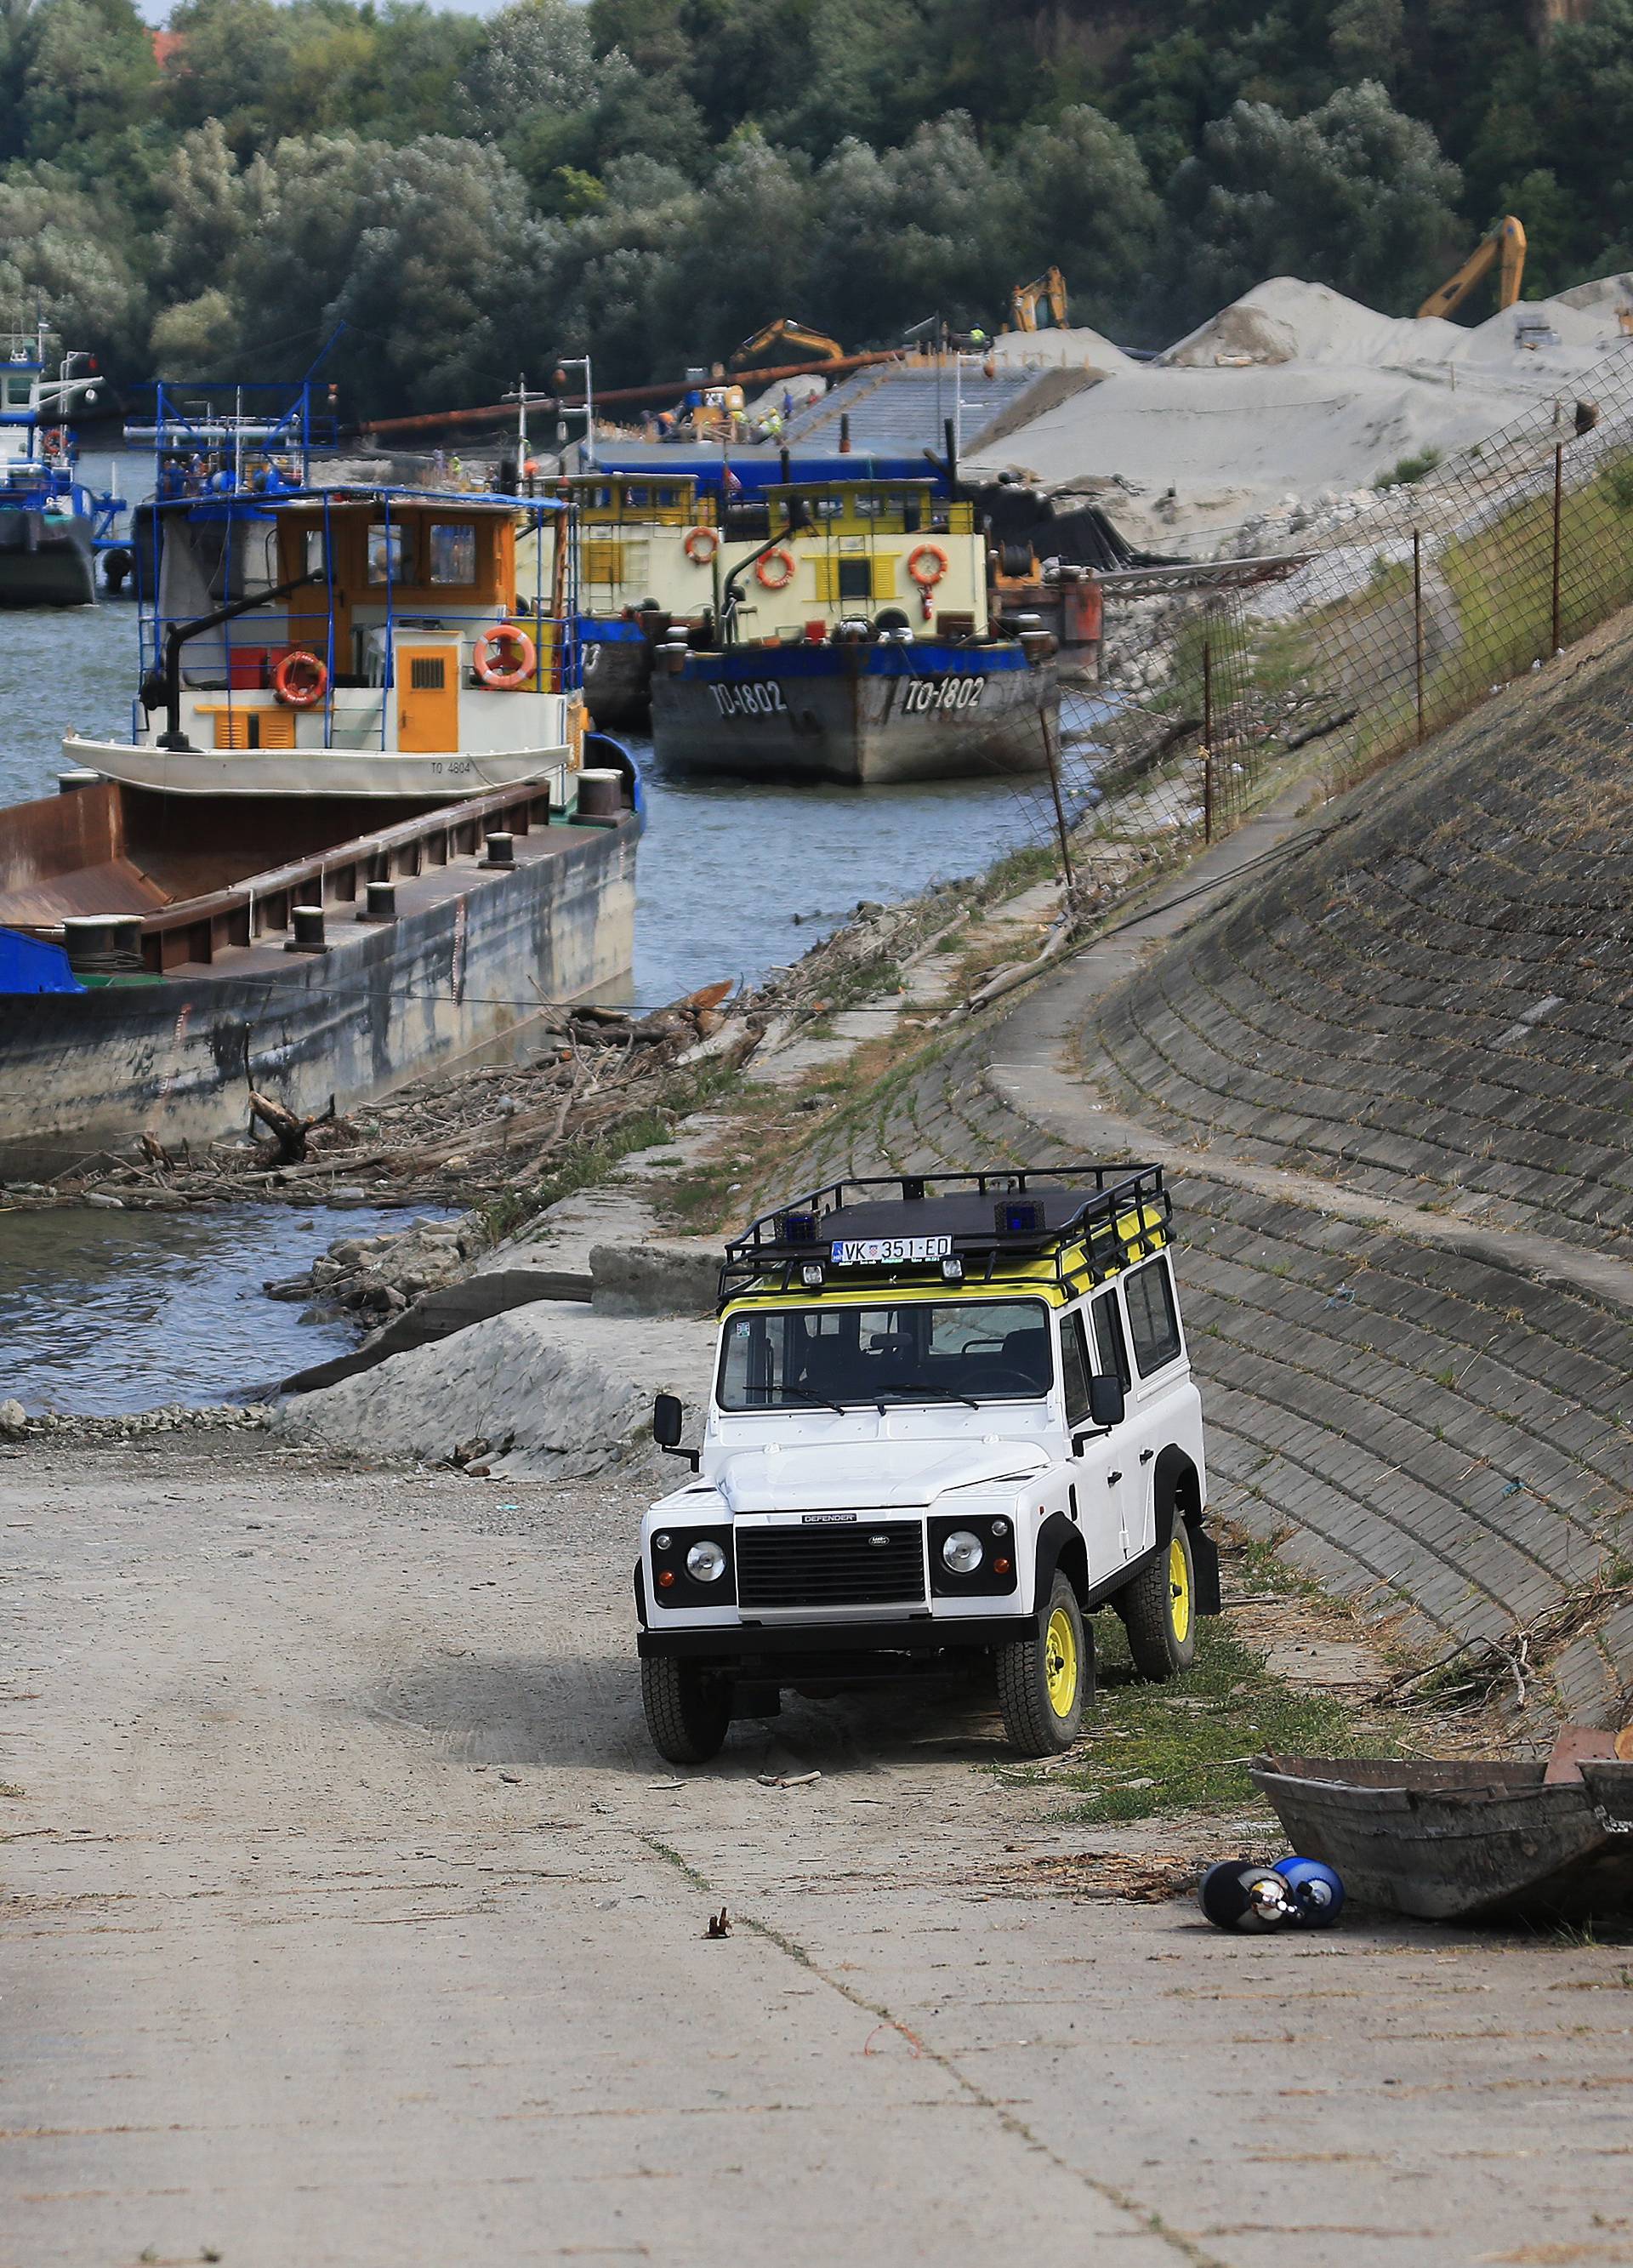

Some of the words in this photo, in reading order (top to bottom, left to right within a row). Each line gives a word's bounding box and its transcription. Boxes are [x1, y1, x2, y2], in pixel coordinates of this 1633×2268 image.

[708, 681, 788, 715] TO-1802
[905, 676, 985, 710] TO-1802
[431, 762, 442, 774] TO
[447, 762, 470, 774] 4804
[845, 1242, 867, 1260] VK
[881, 1238, 948, 1258] 351-ED
[804, 1514, 855, 1523] DEFENDER
